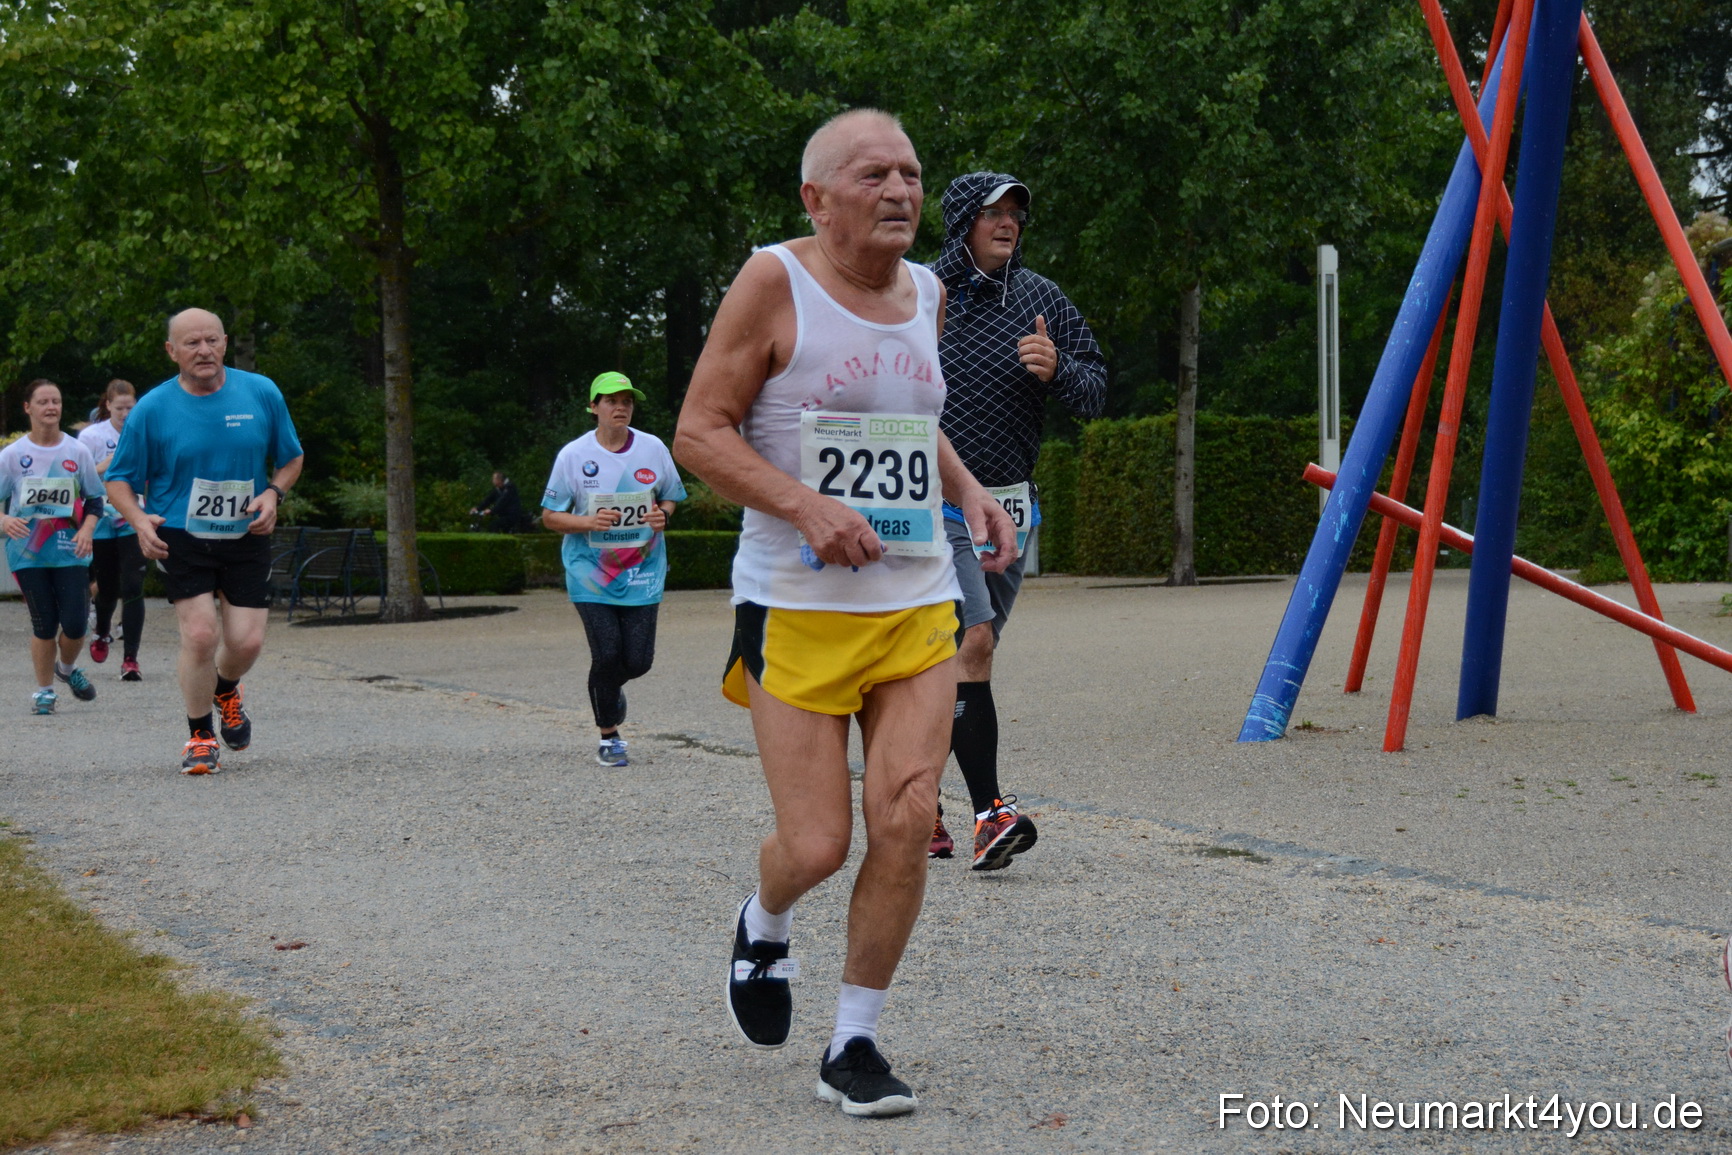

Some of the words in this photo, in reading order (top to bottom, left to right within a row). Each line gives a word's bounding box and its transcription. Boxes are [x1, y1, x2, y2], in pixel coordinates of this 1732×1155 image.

[814, 427, 862, 438] NeuerMarkt
[869, 419, 928, 437] BOCK
[818, 447, 929, 501] 2239
[26, 488, 70, 505] 2640
[195, 495, 251, 517] 2814
[210, 522, 235, 532] Franz
[603, 532, 640, 541] Christine
